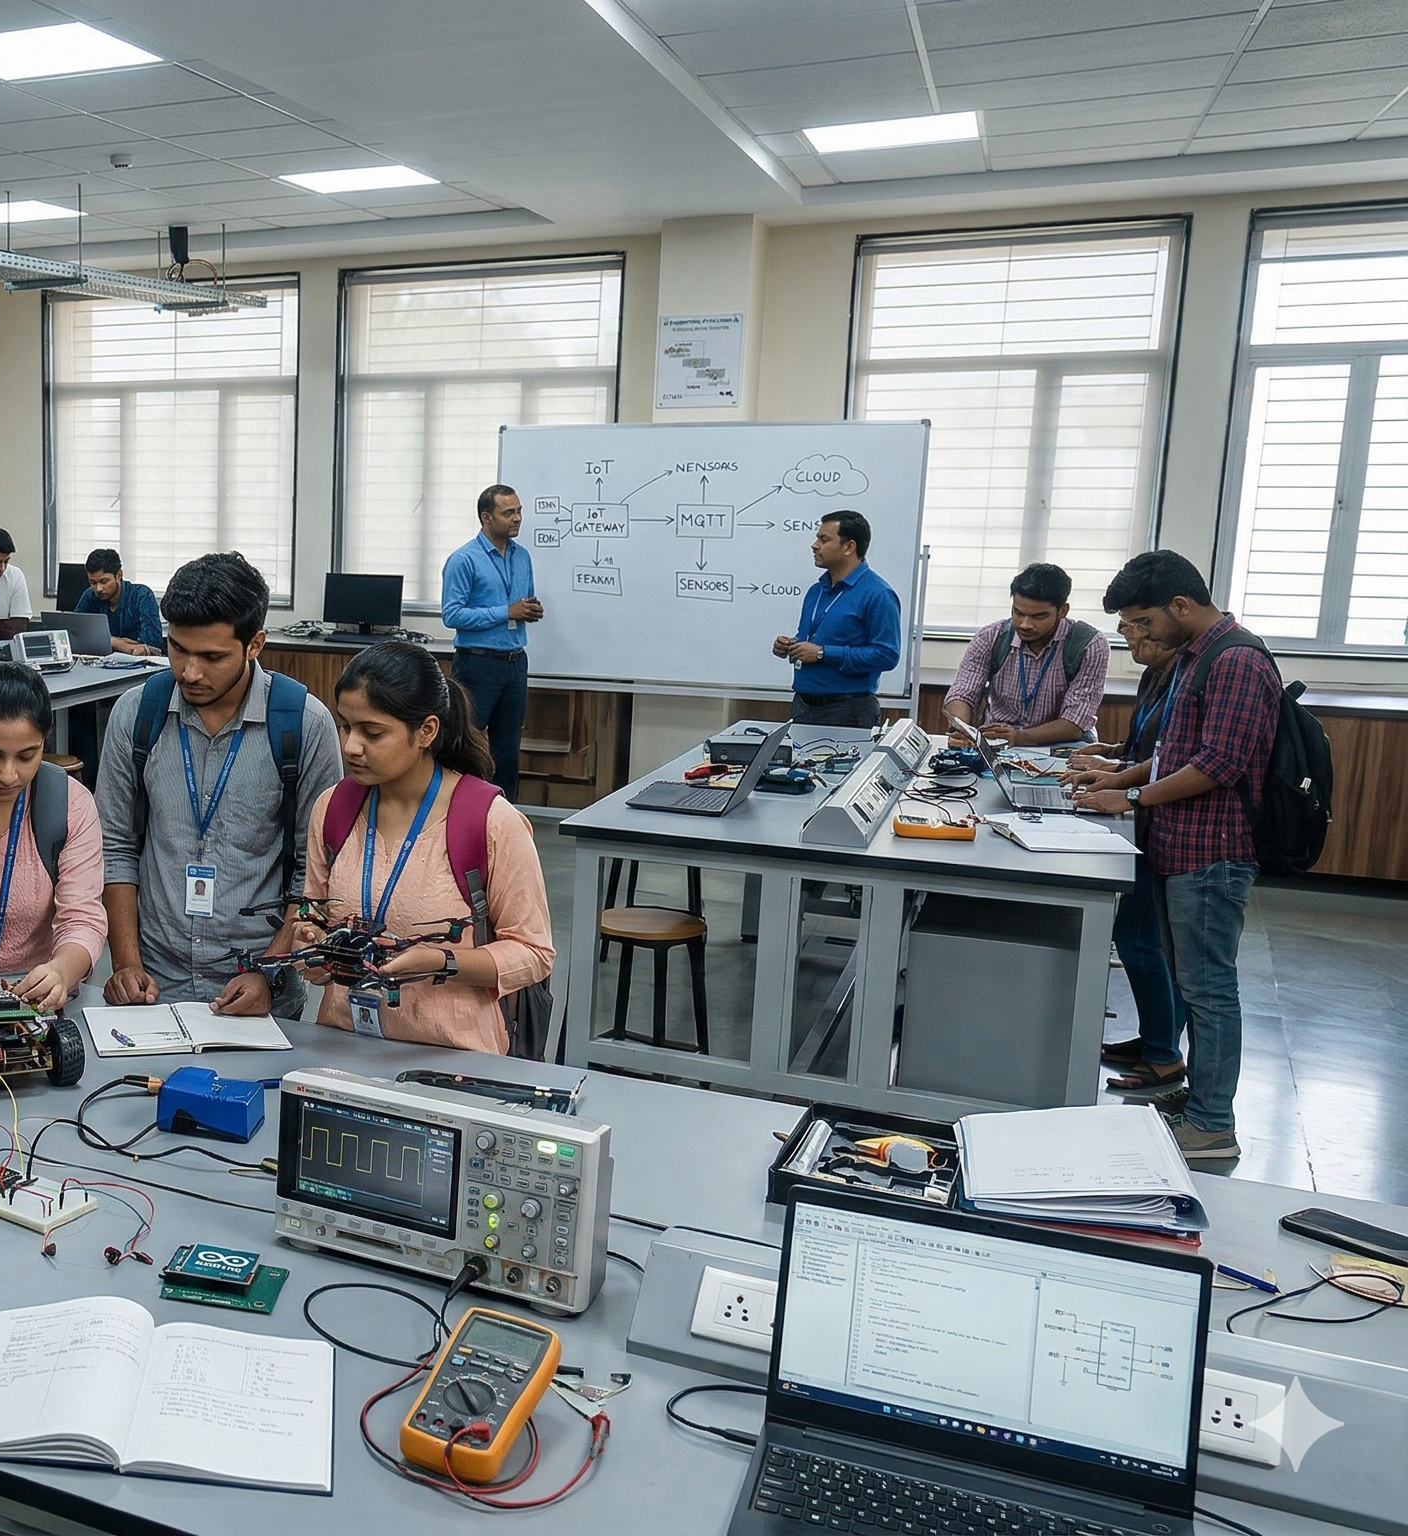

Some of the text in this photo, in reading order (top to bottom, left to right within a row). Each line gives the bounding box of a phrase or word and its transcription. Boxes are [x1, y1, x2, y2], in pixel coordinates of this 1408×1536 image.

[585, 459, 614, 475] IoT
[795, 471, 841, 483] CLOUD
[586, 507, 606, 519] IoT
[681, 513, 726, 528] MQTT
[574, 522, 625, 534] GATEWAY
[761, 583, 802, 596] CLOUD
